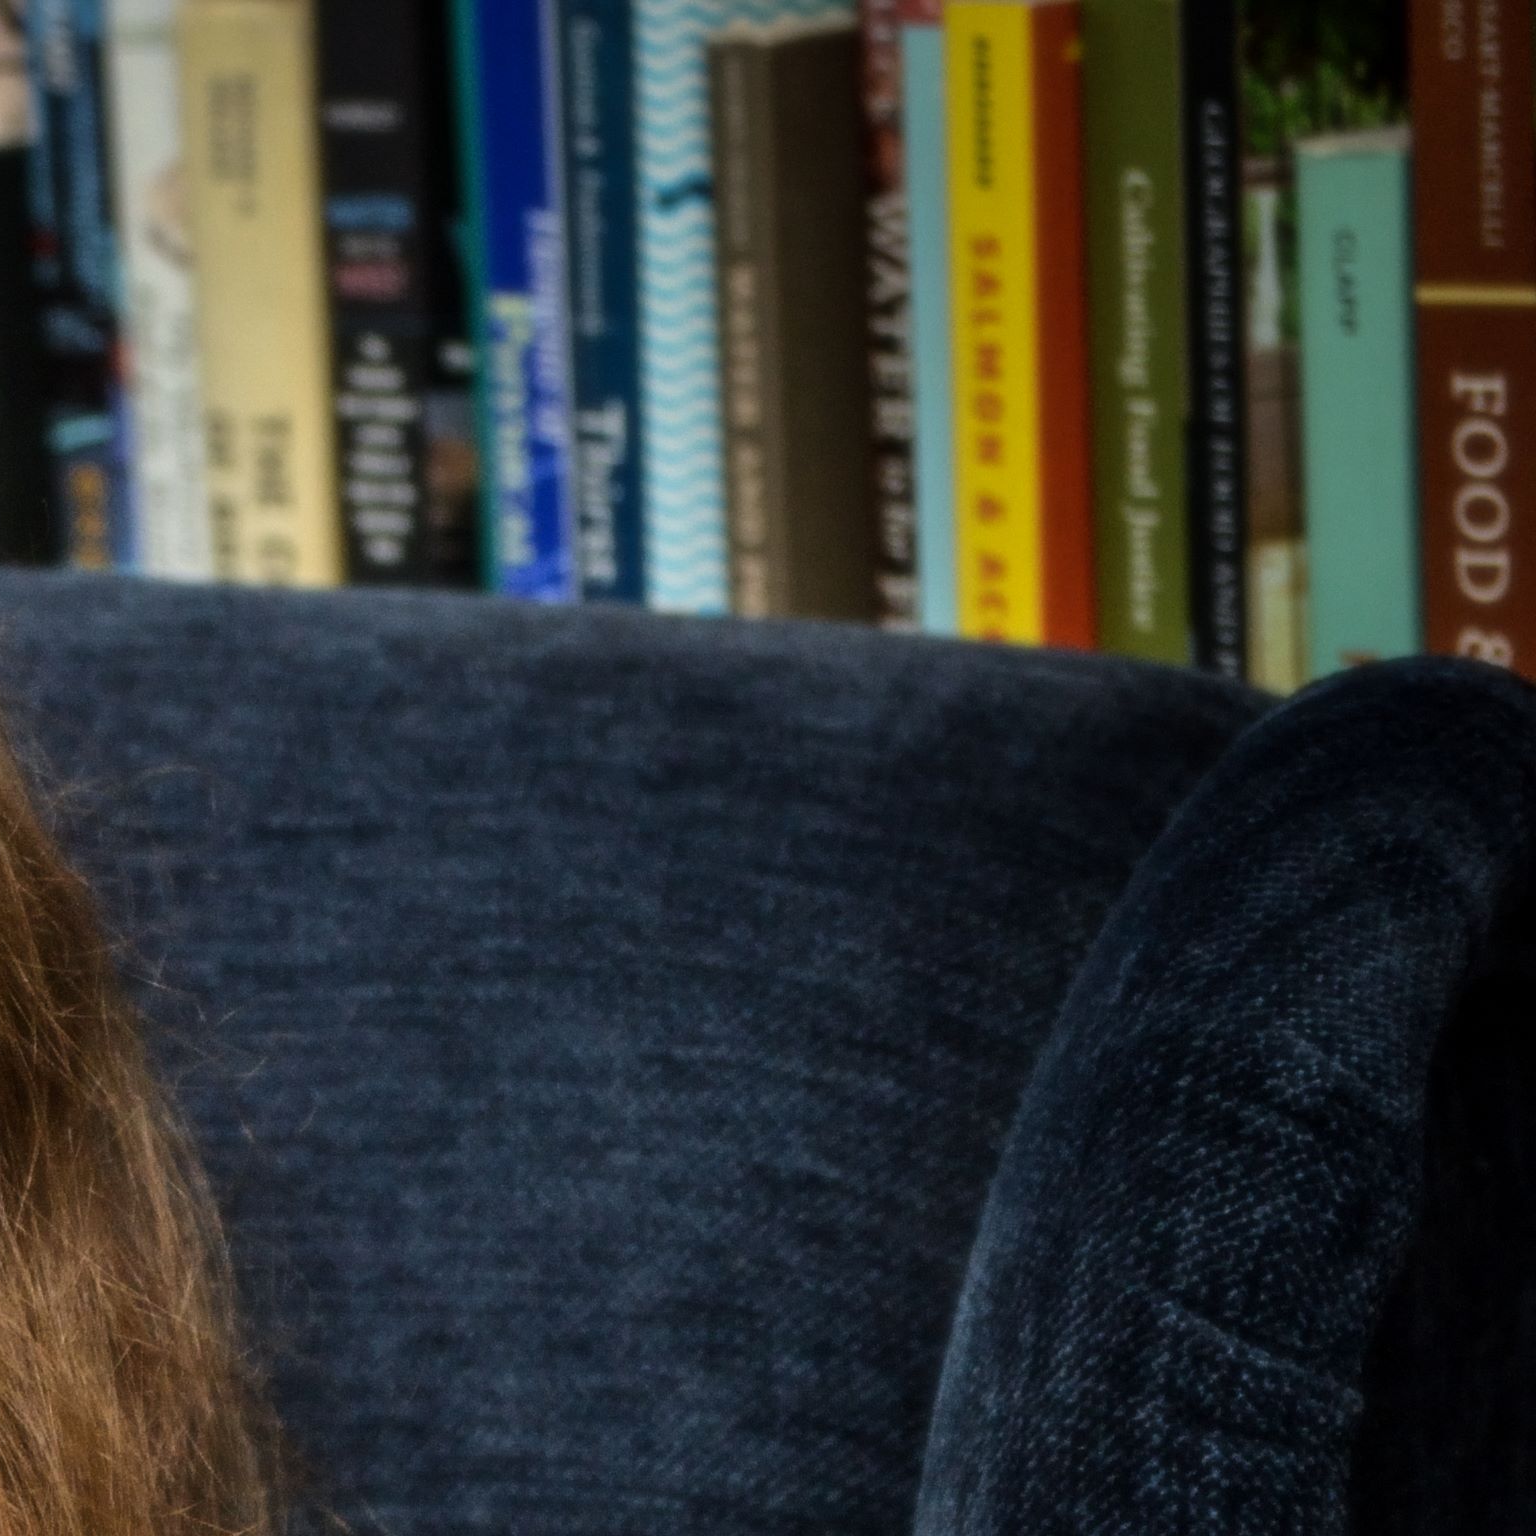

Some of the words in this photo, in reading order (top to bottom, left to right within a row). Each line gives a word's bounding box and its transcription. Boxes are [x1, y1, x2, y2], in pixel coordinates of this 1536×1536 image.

[866, 193, 916, 440] WATER
[969, 234, 1005, 468] SALMON
[1125, 397, 1160, 499] Food
[1451, 370, 1511, 604] FOOD
[1122, 501, 1163, 634] Justice
